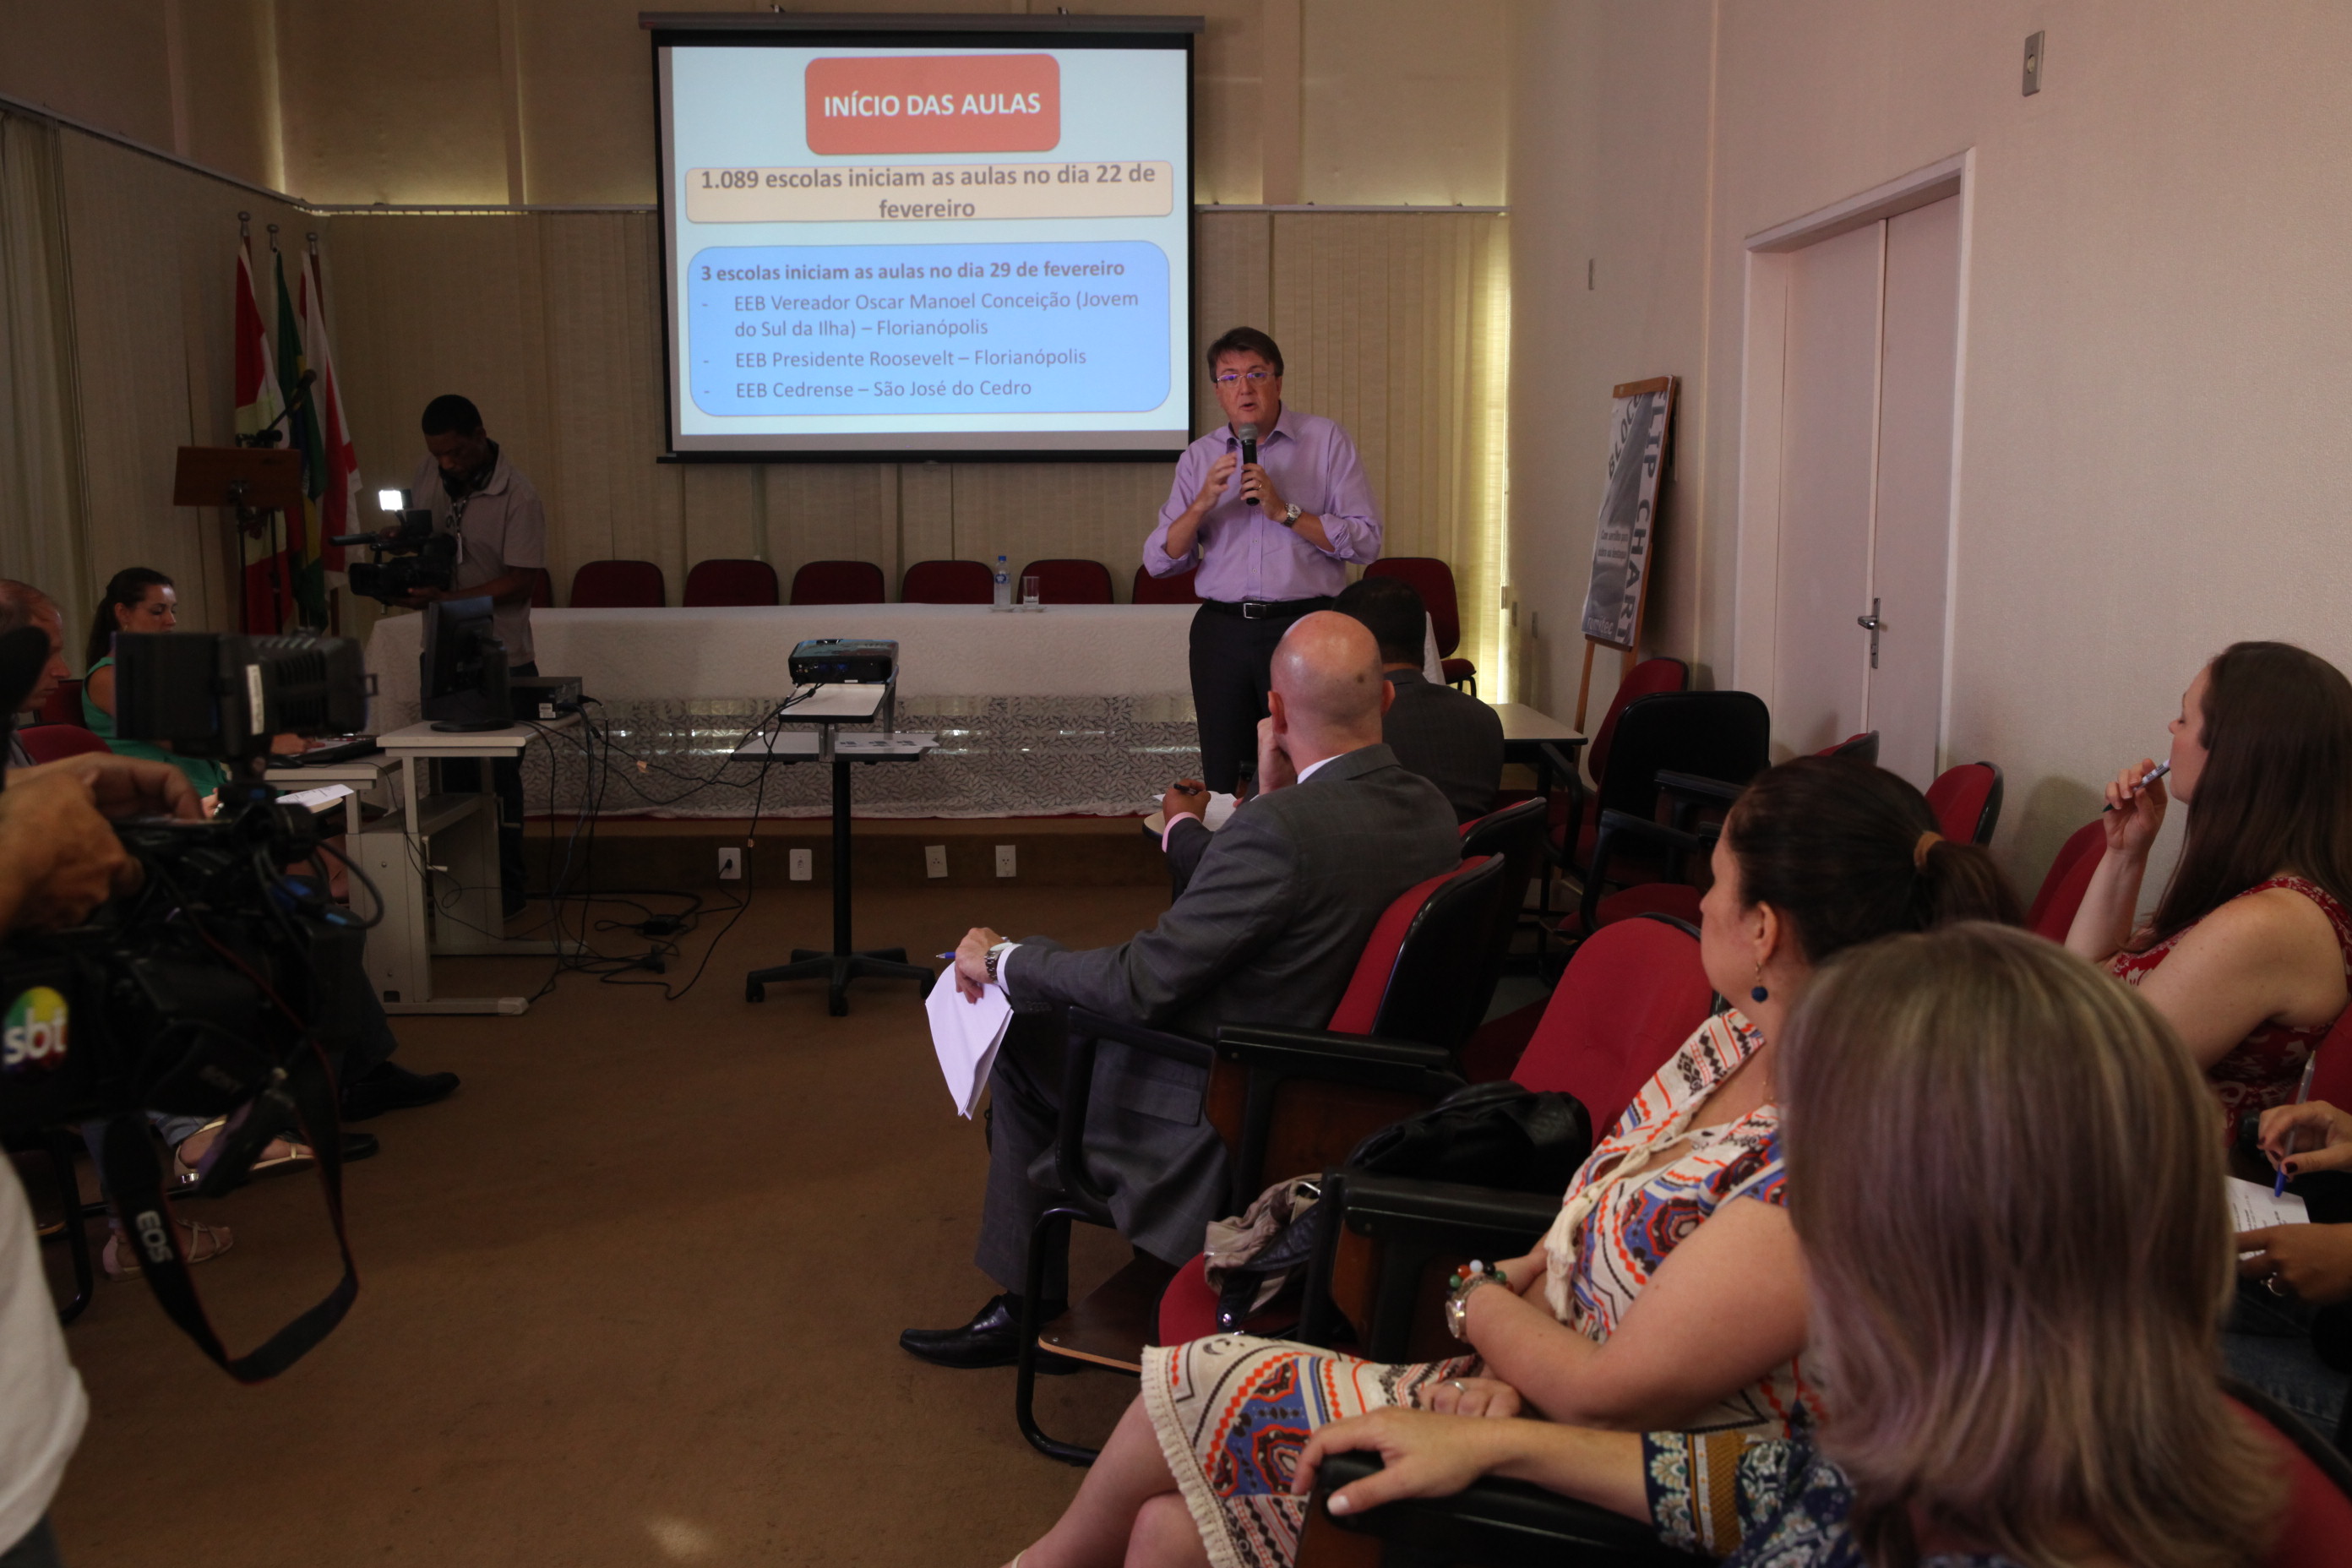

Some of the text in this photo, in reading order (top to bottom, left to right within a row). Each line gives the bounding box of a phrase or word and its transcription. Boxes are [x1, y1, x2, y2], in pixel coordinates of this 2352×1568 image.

[825, 90, 1041, 117] INÍCIO DAS AULAS
[701, 162, 1156, 189] 1.089 escolas iniciam as aulas no dia 22 de
[879, 198, 977, 219] fevereiro
[700, 259, 1125, 281] 3 escolas iniciam as aulas no dia 29 de fevereiro
[734, 295, 766, 312] EEB
[770, 294, 851, 311] Vereador
[855, 293, 905, 310] Oscar
[910, 291, 976, 309] Manoel
[981, 291, 1071, 312] Conceição
[1076, 290, 1139, 310] (Jovem
[734, 320, 757, 338] do
[761, 319, 787, 337] Sul
[792, 319, 813, 337] da
[819, 319, 856, 339] Ilha)
[877, 318, 988, 339] Florianópolis
[736, 351, 767, 368] EEB
[772, 351, 864, 368] Presidente
[869, 349, 955, 367] Roosevelt
[975, 347, 1087, 368] Florianópolis
[736, 382, 768, 399] EEB
[773, 381, 854, 398] Cedrense
[874, 380, 906, 397] São
[909, 379, 946, 396] José
[952, 379, 974, 396] do
[979, 378, 1032, 395] Cedro
[1642, 391, 1667, 478] LIP
[3, 1006, 68, 1065] sbt
[136, 1210, 174, 1264] EOS
